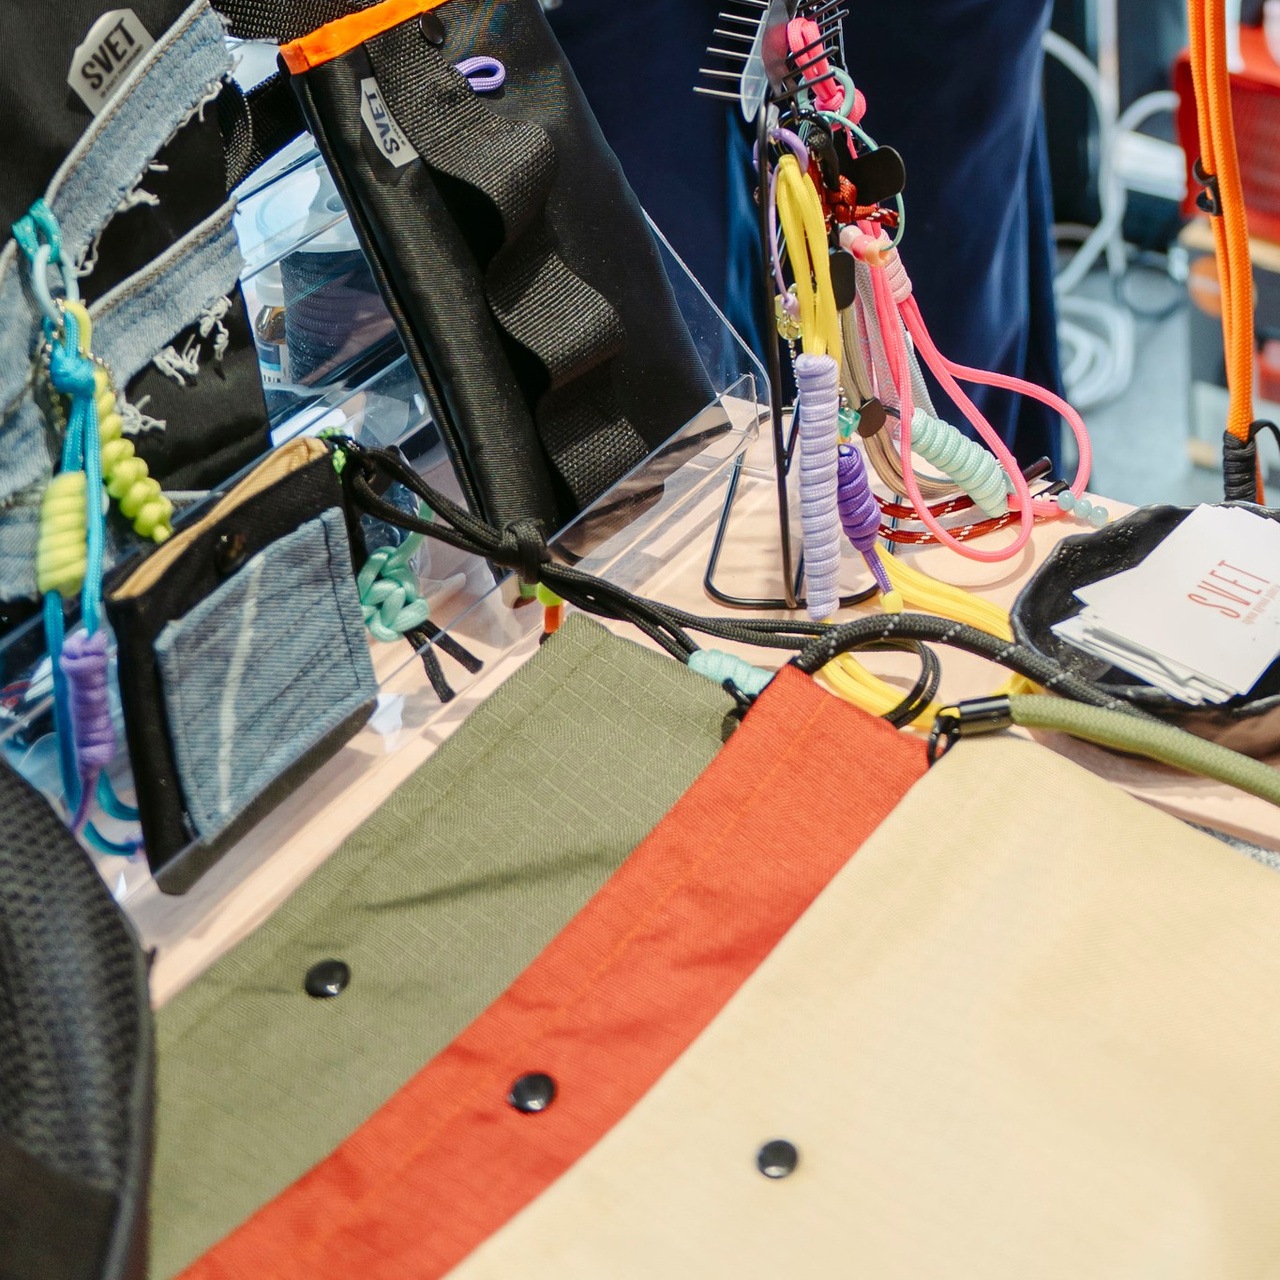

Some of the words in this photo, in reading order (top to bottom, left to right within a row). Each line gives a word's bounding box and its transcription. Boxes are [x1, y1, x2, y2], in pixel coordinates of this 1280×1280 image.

[81, 17, 136, 90] SVET
[364, 90, 400, 154] SVET
[1187, 559, 1271, 619] SVET
